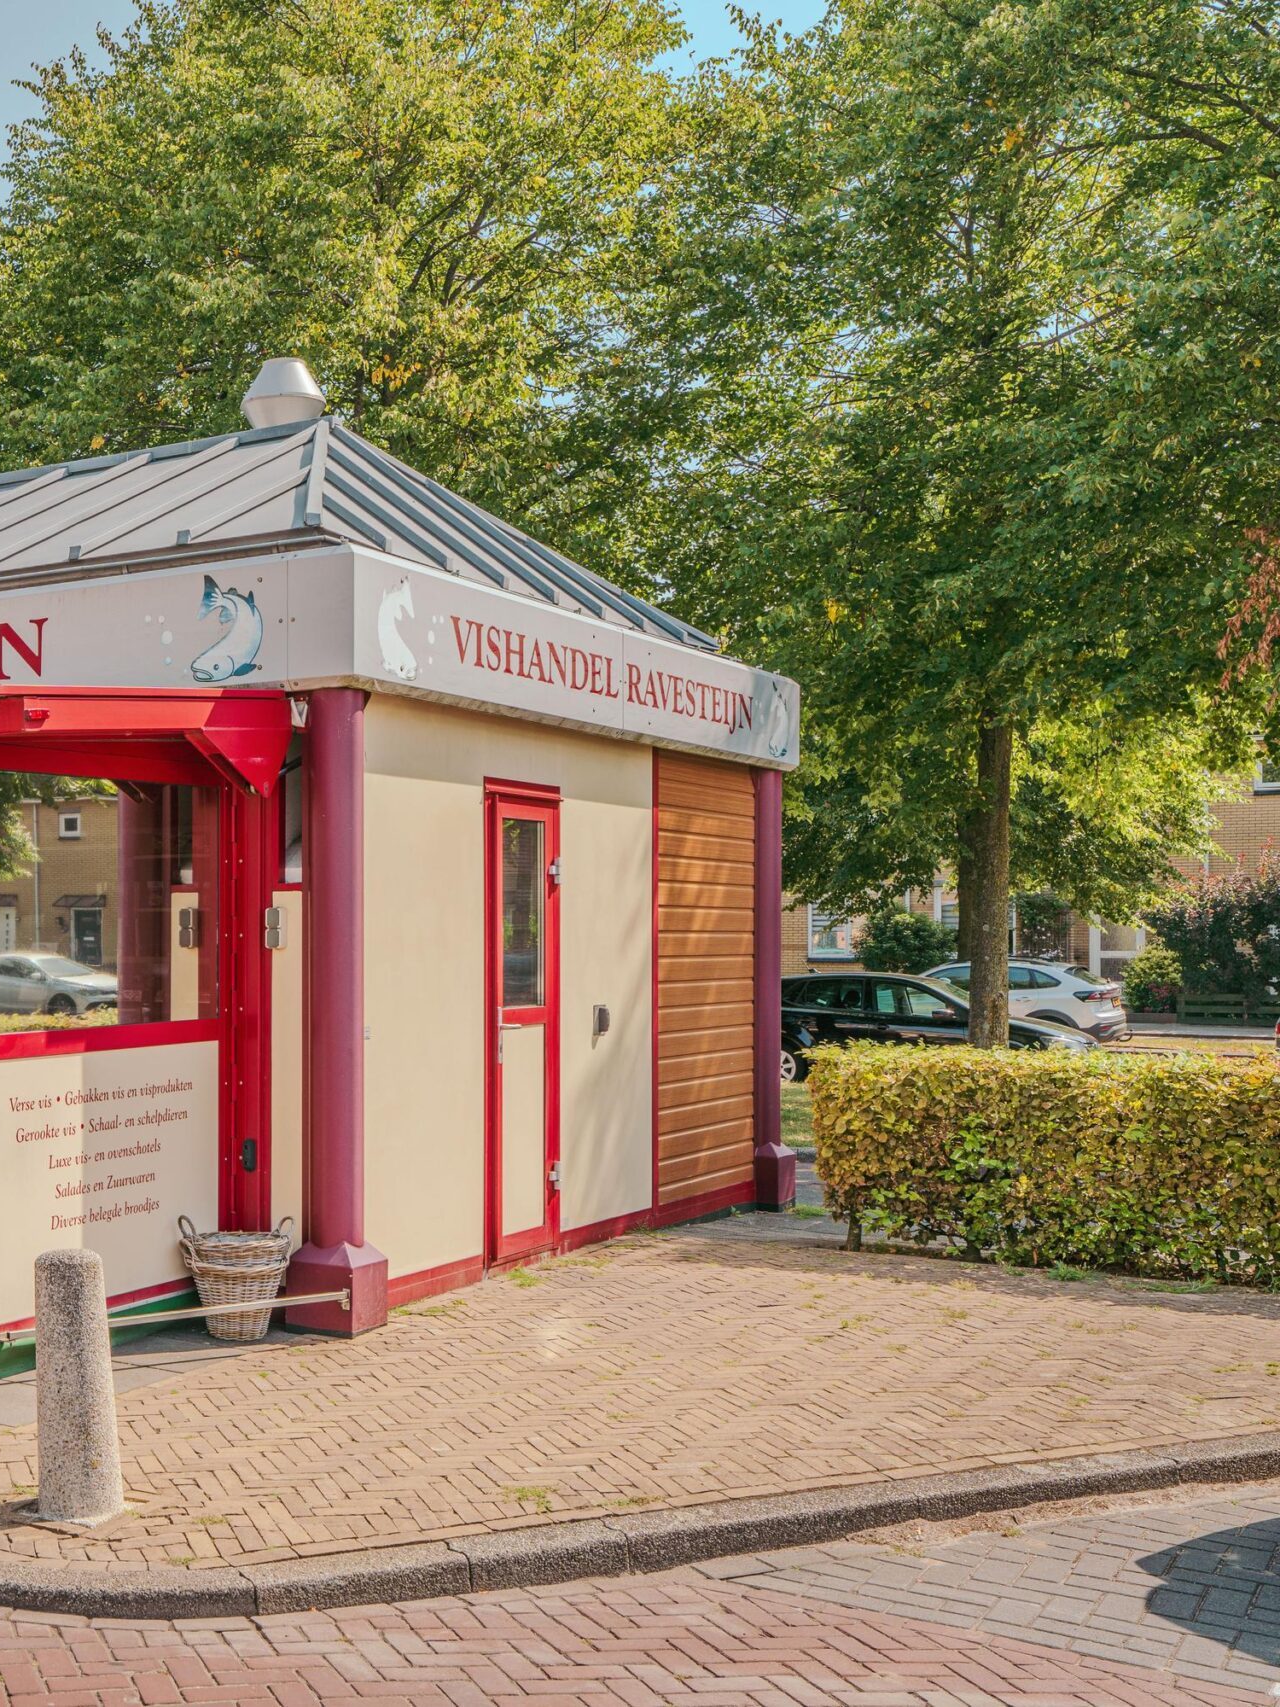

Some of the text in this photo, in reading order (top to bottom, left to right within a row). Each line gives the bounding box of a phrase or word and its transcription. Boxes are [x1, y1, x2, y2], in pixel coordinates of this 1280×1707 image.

[450, 615, 754, 735] VISHANDEL RAVESTEIJN
[10, 1078, 193, 1112] Verse vis Gebakken vis en visprodukten
[15, 1107, 188, 1143] Gerookte vis Schaal- en schelpdieren
[48, 1138, 161, 1170] Luxe vis- en ovenschotels
[55, 1172, 156, 1199] Salades en Zuurwaren
[51, 1197, 160, 1230] Diverse belegde broodjes
